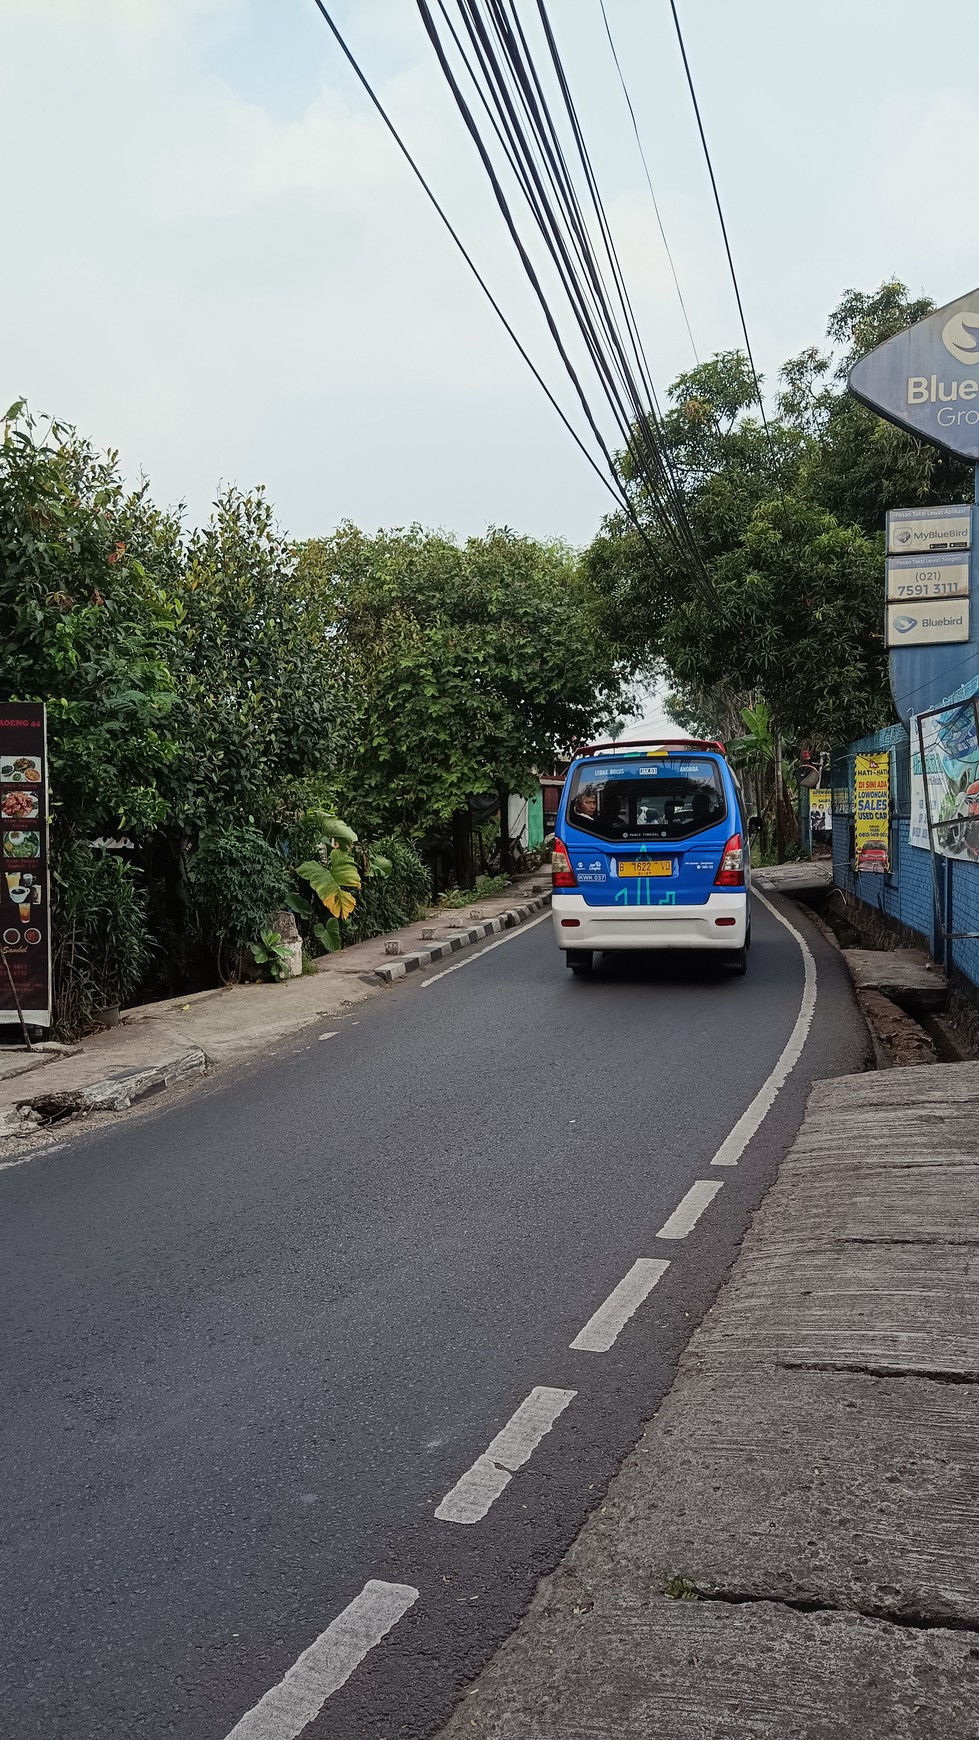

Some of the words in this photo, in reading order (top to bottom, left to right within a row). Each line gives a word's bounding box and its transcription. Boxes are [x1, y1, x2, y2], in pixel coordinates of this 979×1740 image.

[913, 529, 968, 541] MyBlueBird
[915, 571, 941, 582] (021)
[898, 584, 929, 596] 7591
[933, 582, 959, 594] 3111
[922, 616, 963, 627] Bluebird
[594, 768, 608, 776] LEBAK
[877, 780, 887, 788] ADA
[858, 790, 888, 798] LOWONGAN
[857, 799, 888, 811] SALES
[858, 811, 874, 820] USED
[874, 811, 888, 820] CAR
[619, 863, 625, 872] B
[631, 862, 651, 872] 1622
[593, 874, 605, 882] 037
